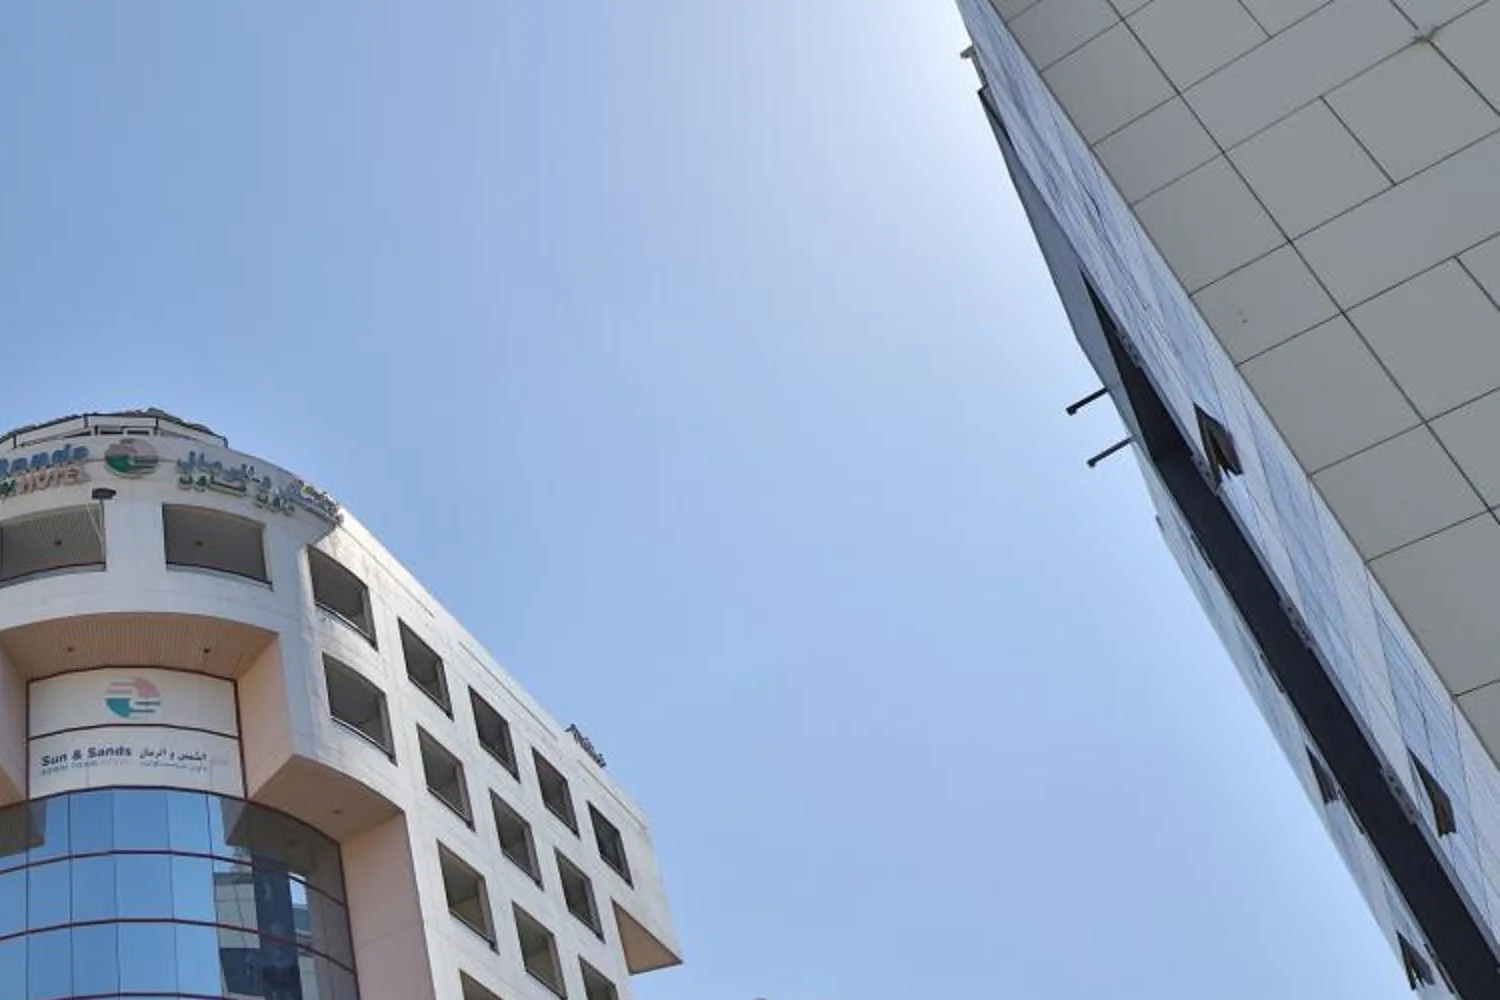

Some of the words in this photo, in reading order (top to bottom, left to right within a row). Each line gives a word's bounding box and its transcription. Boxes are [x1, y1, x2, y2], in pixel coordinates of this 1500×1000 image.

[41, 753, 67, 767] Sun
[71, 749, 82, 761] &
[87, 745, 132, 759] Sands
